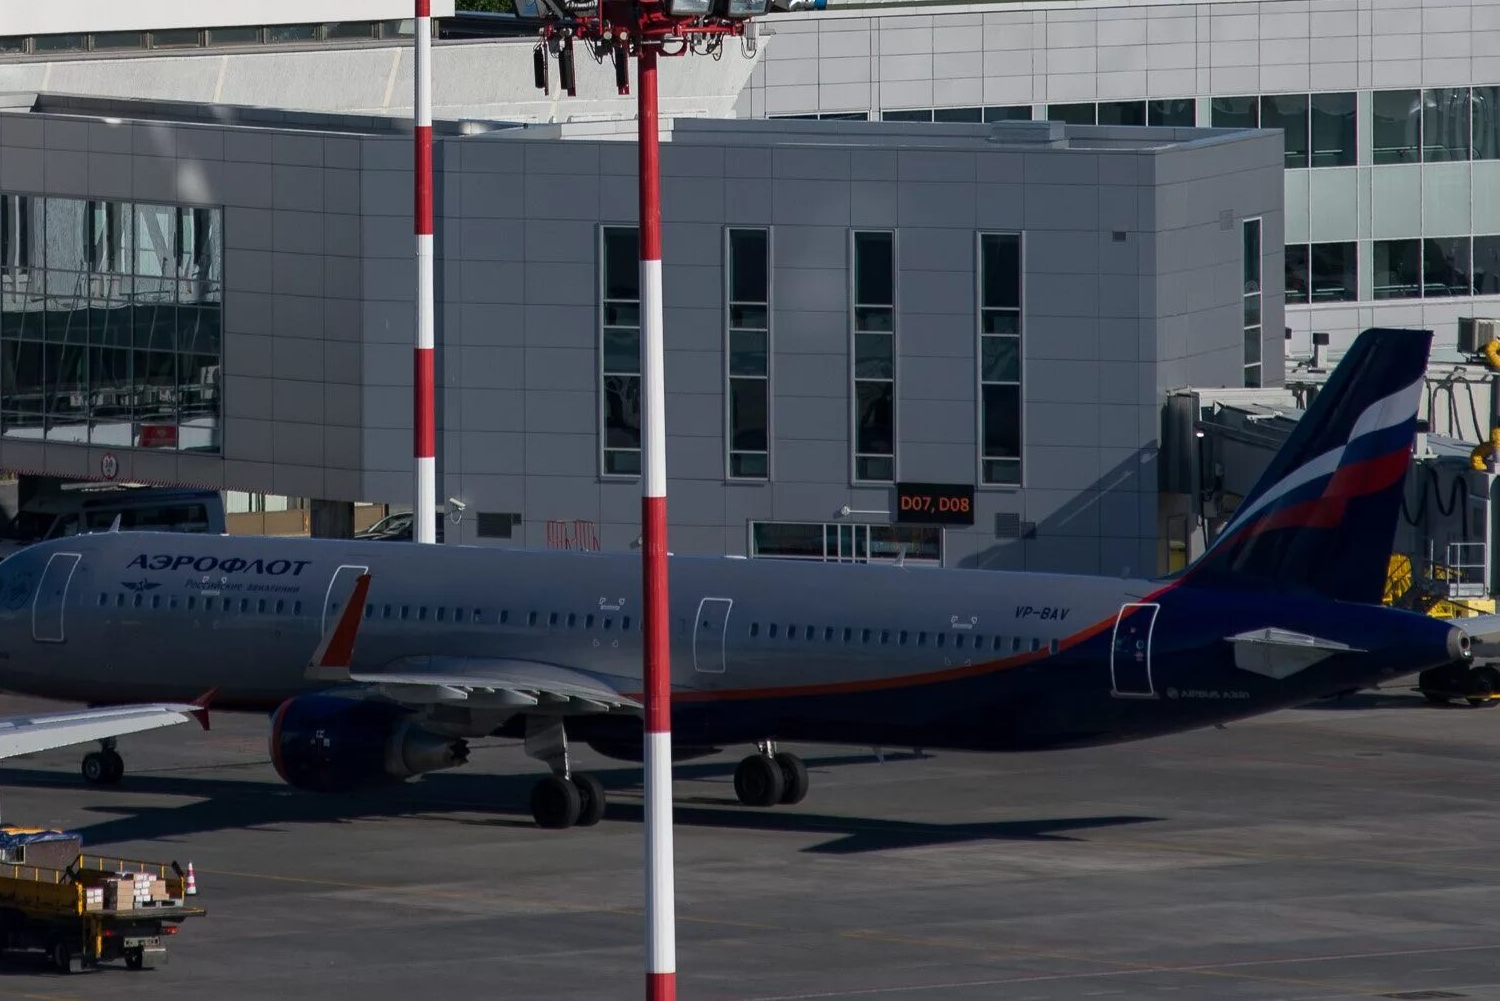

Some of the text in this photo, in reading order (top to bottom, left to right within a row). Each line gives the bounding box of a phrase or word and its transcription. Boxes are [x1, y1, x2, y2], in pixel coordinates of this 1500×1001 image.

[901, 497, 970, 514] D07, D08
[126, 554, 312, 576] АЭРОФЛОТ
